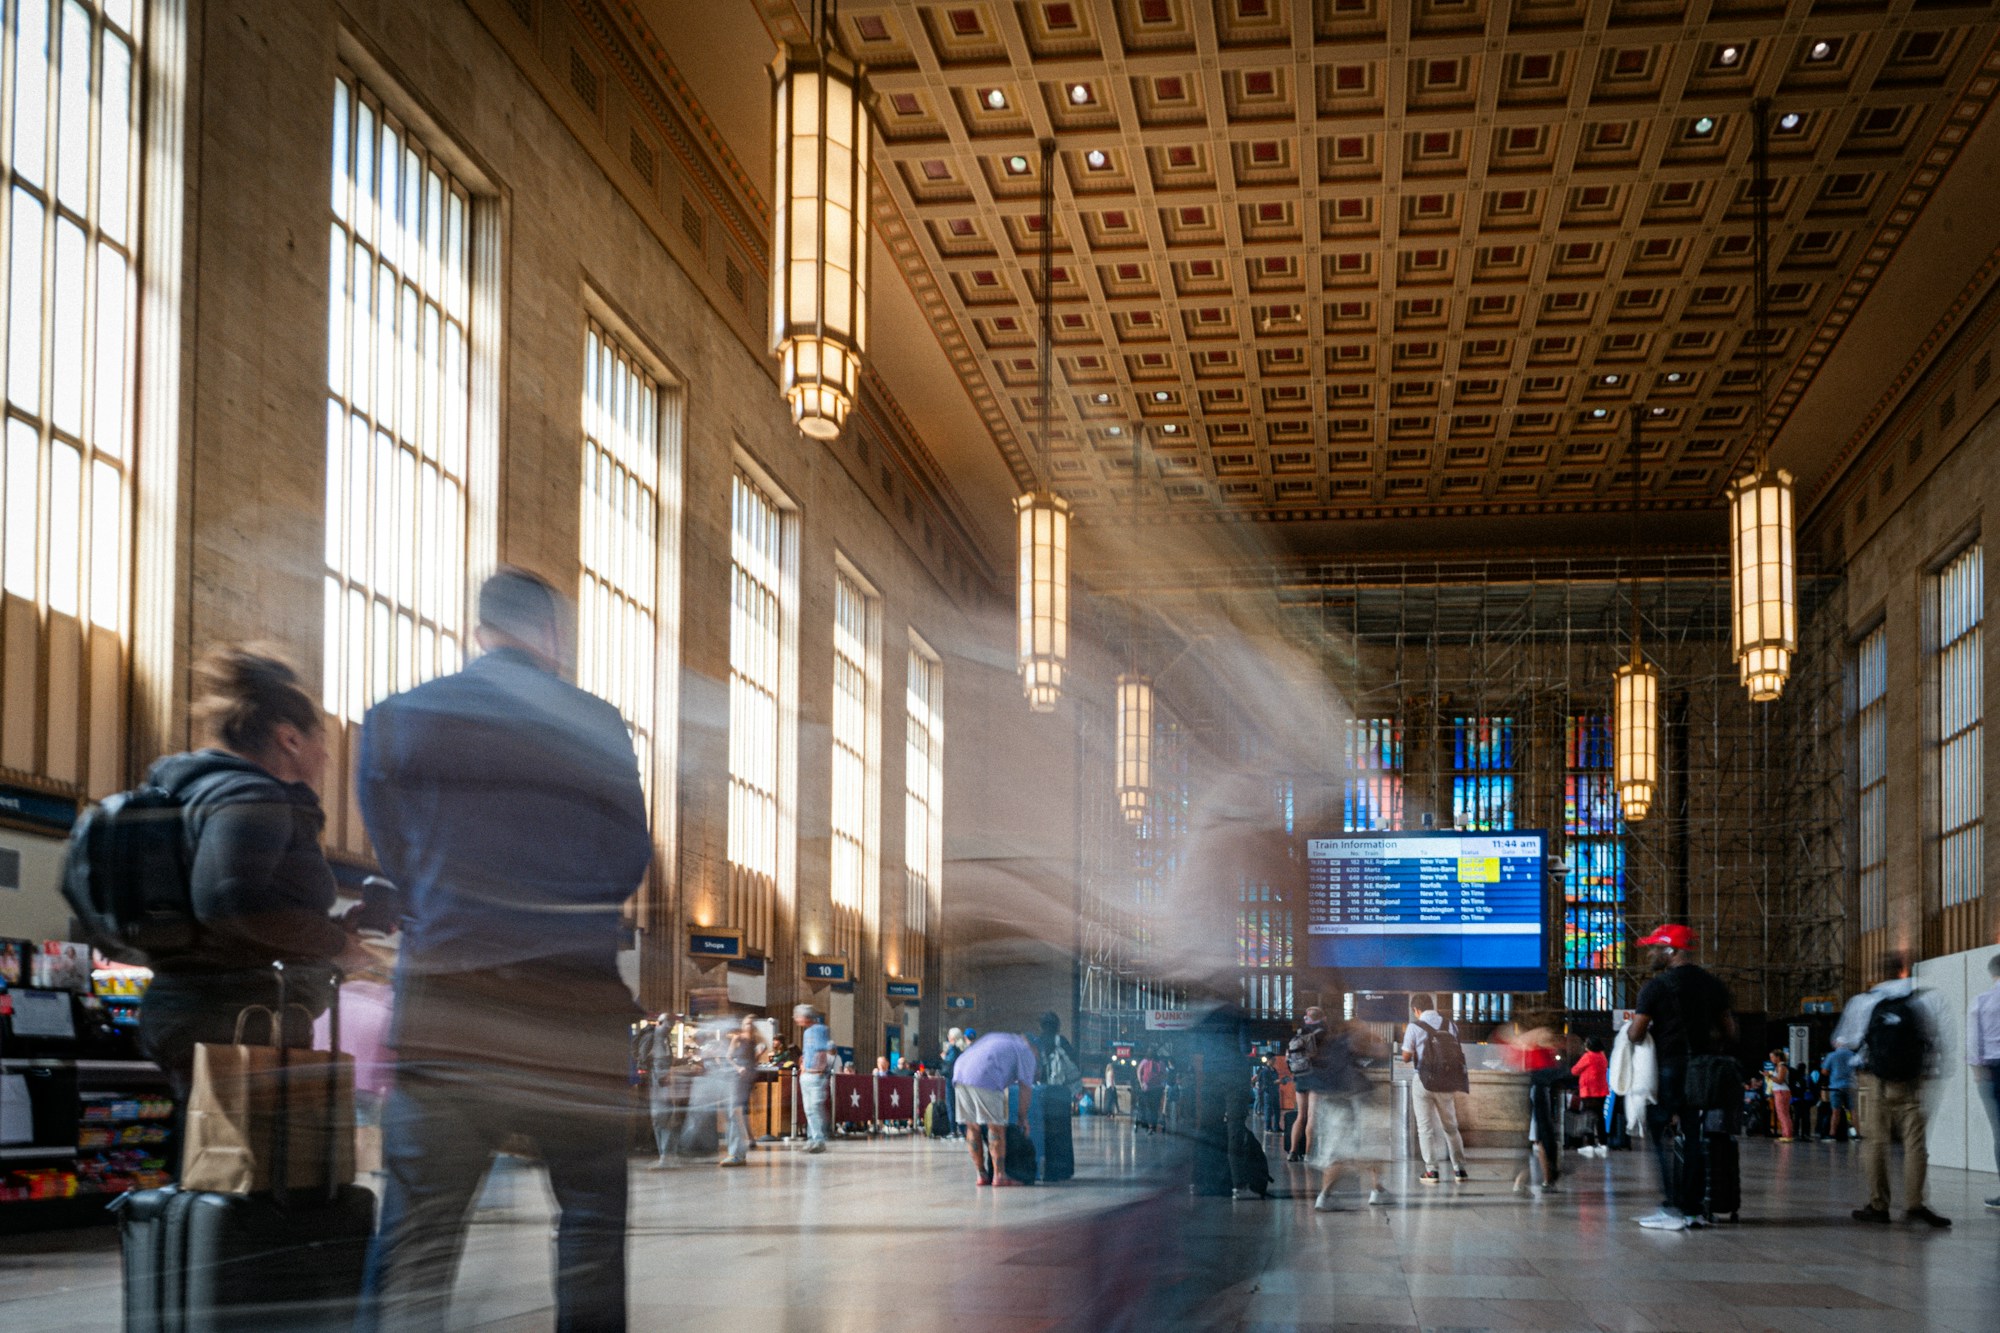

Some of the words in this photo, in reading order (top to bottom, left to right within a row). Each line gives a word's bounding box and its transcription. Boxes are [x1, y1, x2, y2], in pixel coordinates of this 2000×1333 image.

[1315, 841, 1338, 849] Train
[1341, 841, 1397, 849] Information
[1492, 840, 1517, 848] 11:44
[819, 966, 831, 976] 10
